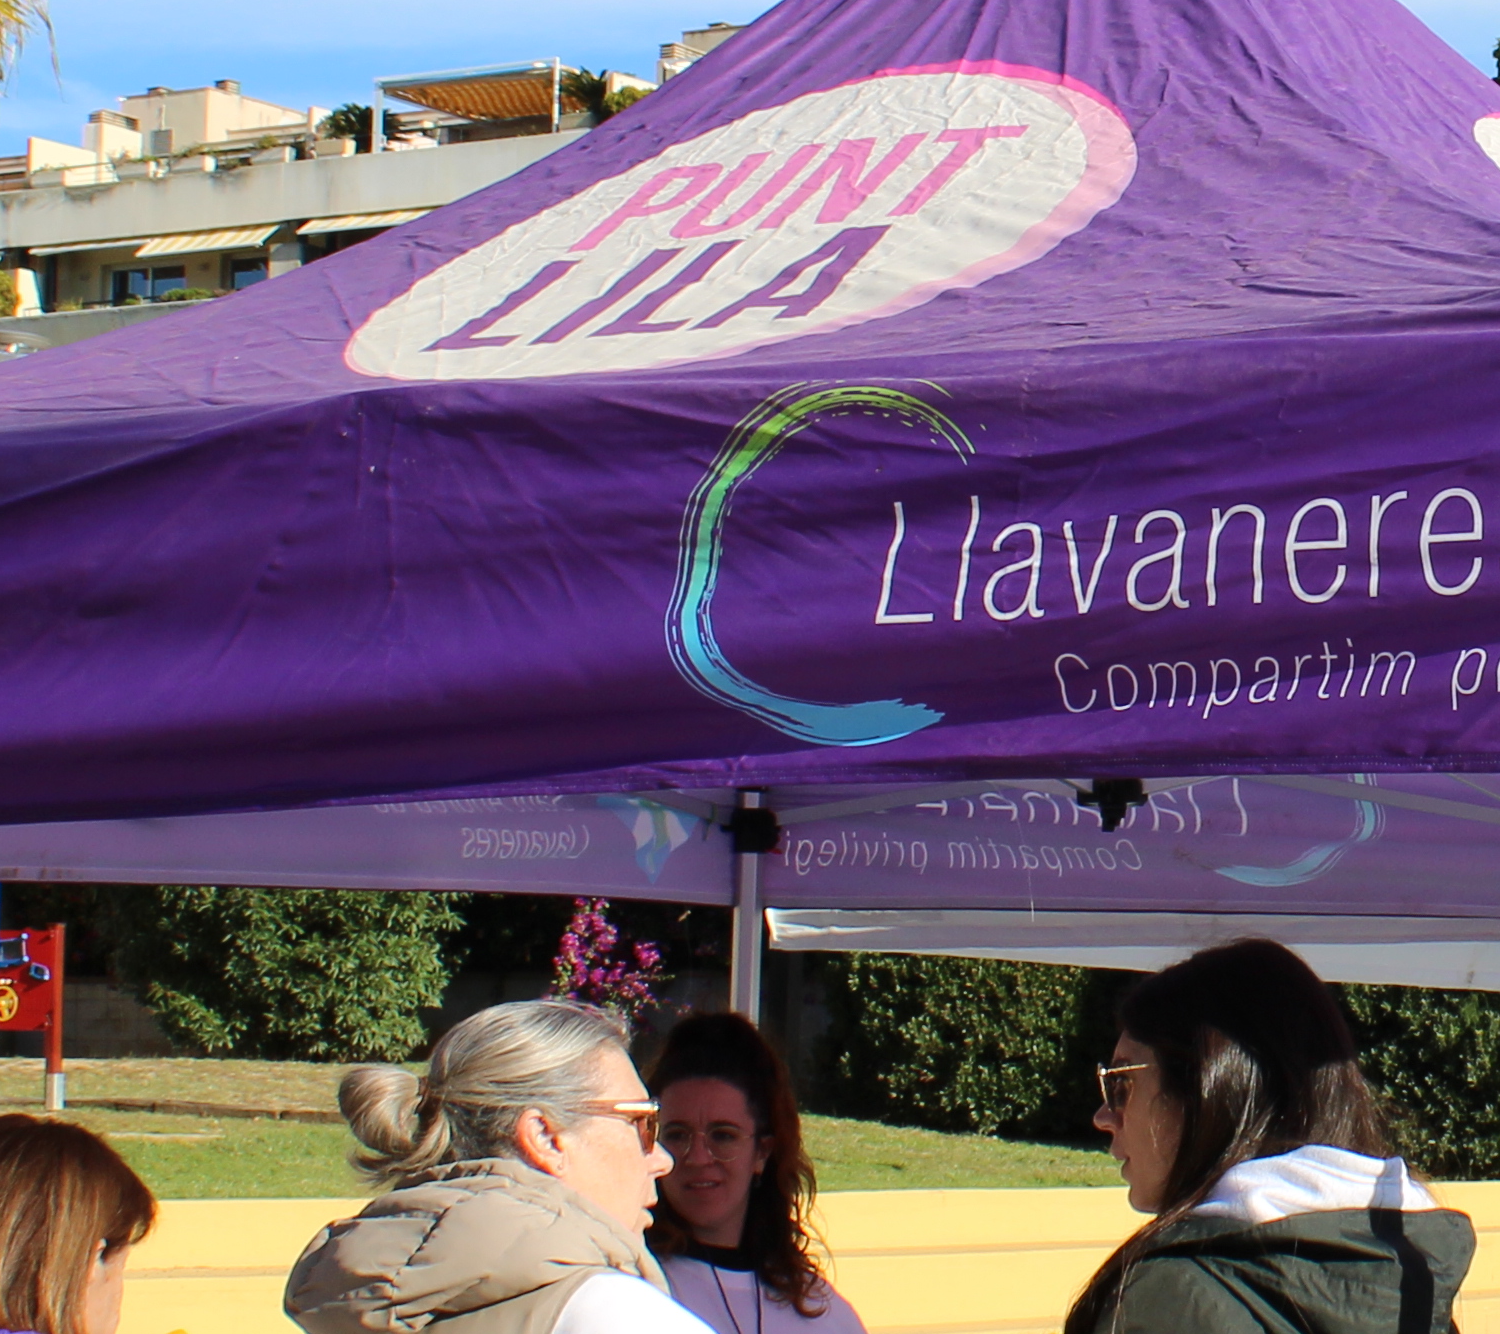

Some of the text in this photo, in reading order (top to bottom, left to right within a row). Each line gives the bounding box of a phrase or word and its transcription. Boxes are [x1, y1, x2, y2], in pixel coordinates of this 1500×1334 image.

[570, 125, 1029, 251] PUNT
[420, 225, 891, 351] LILA
[1056, 639, 1415, 719] Compartim
